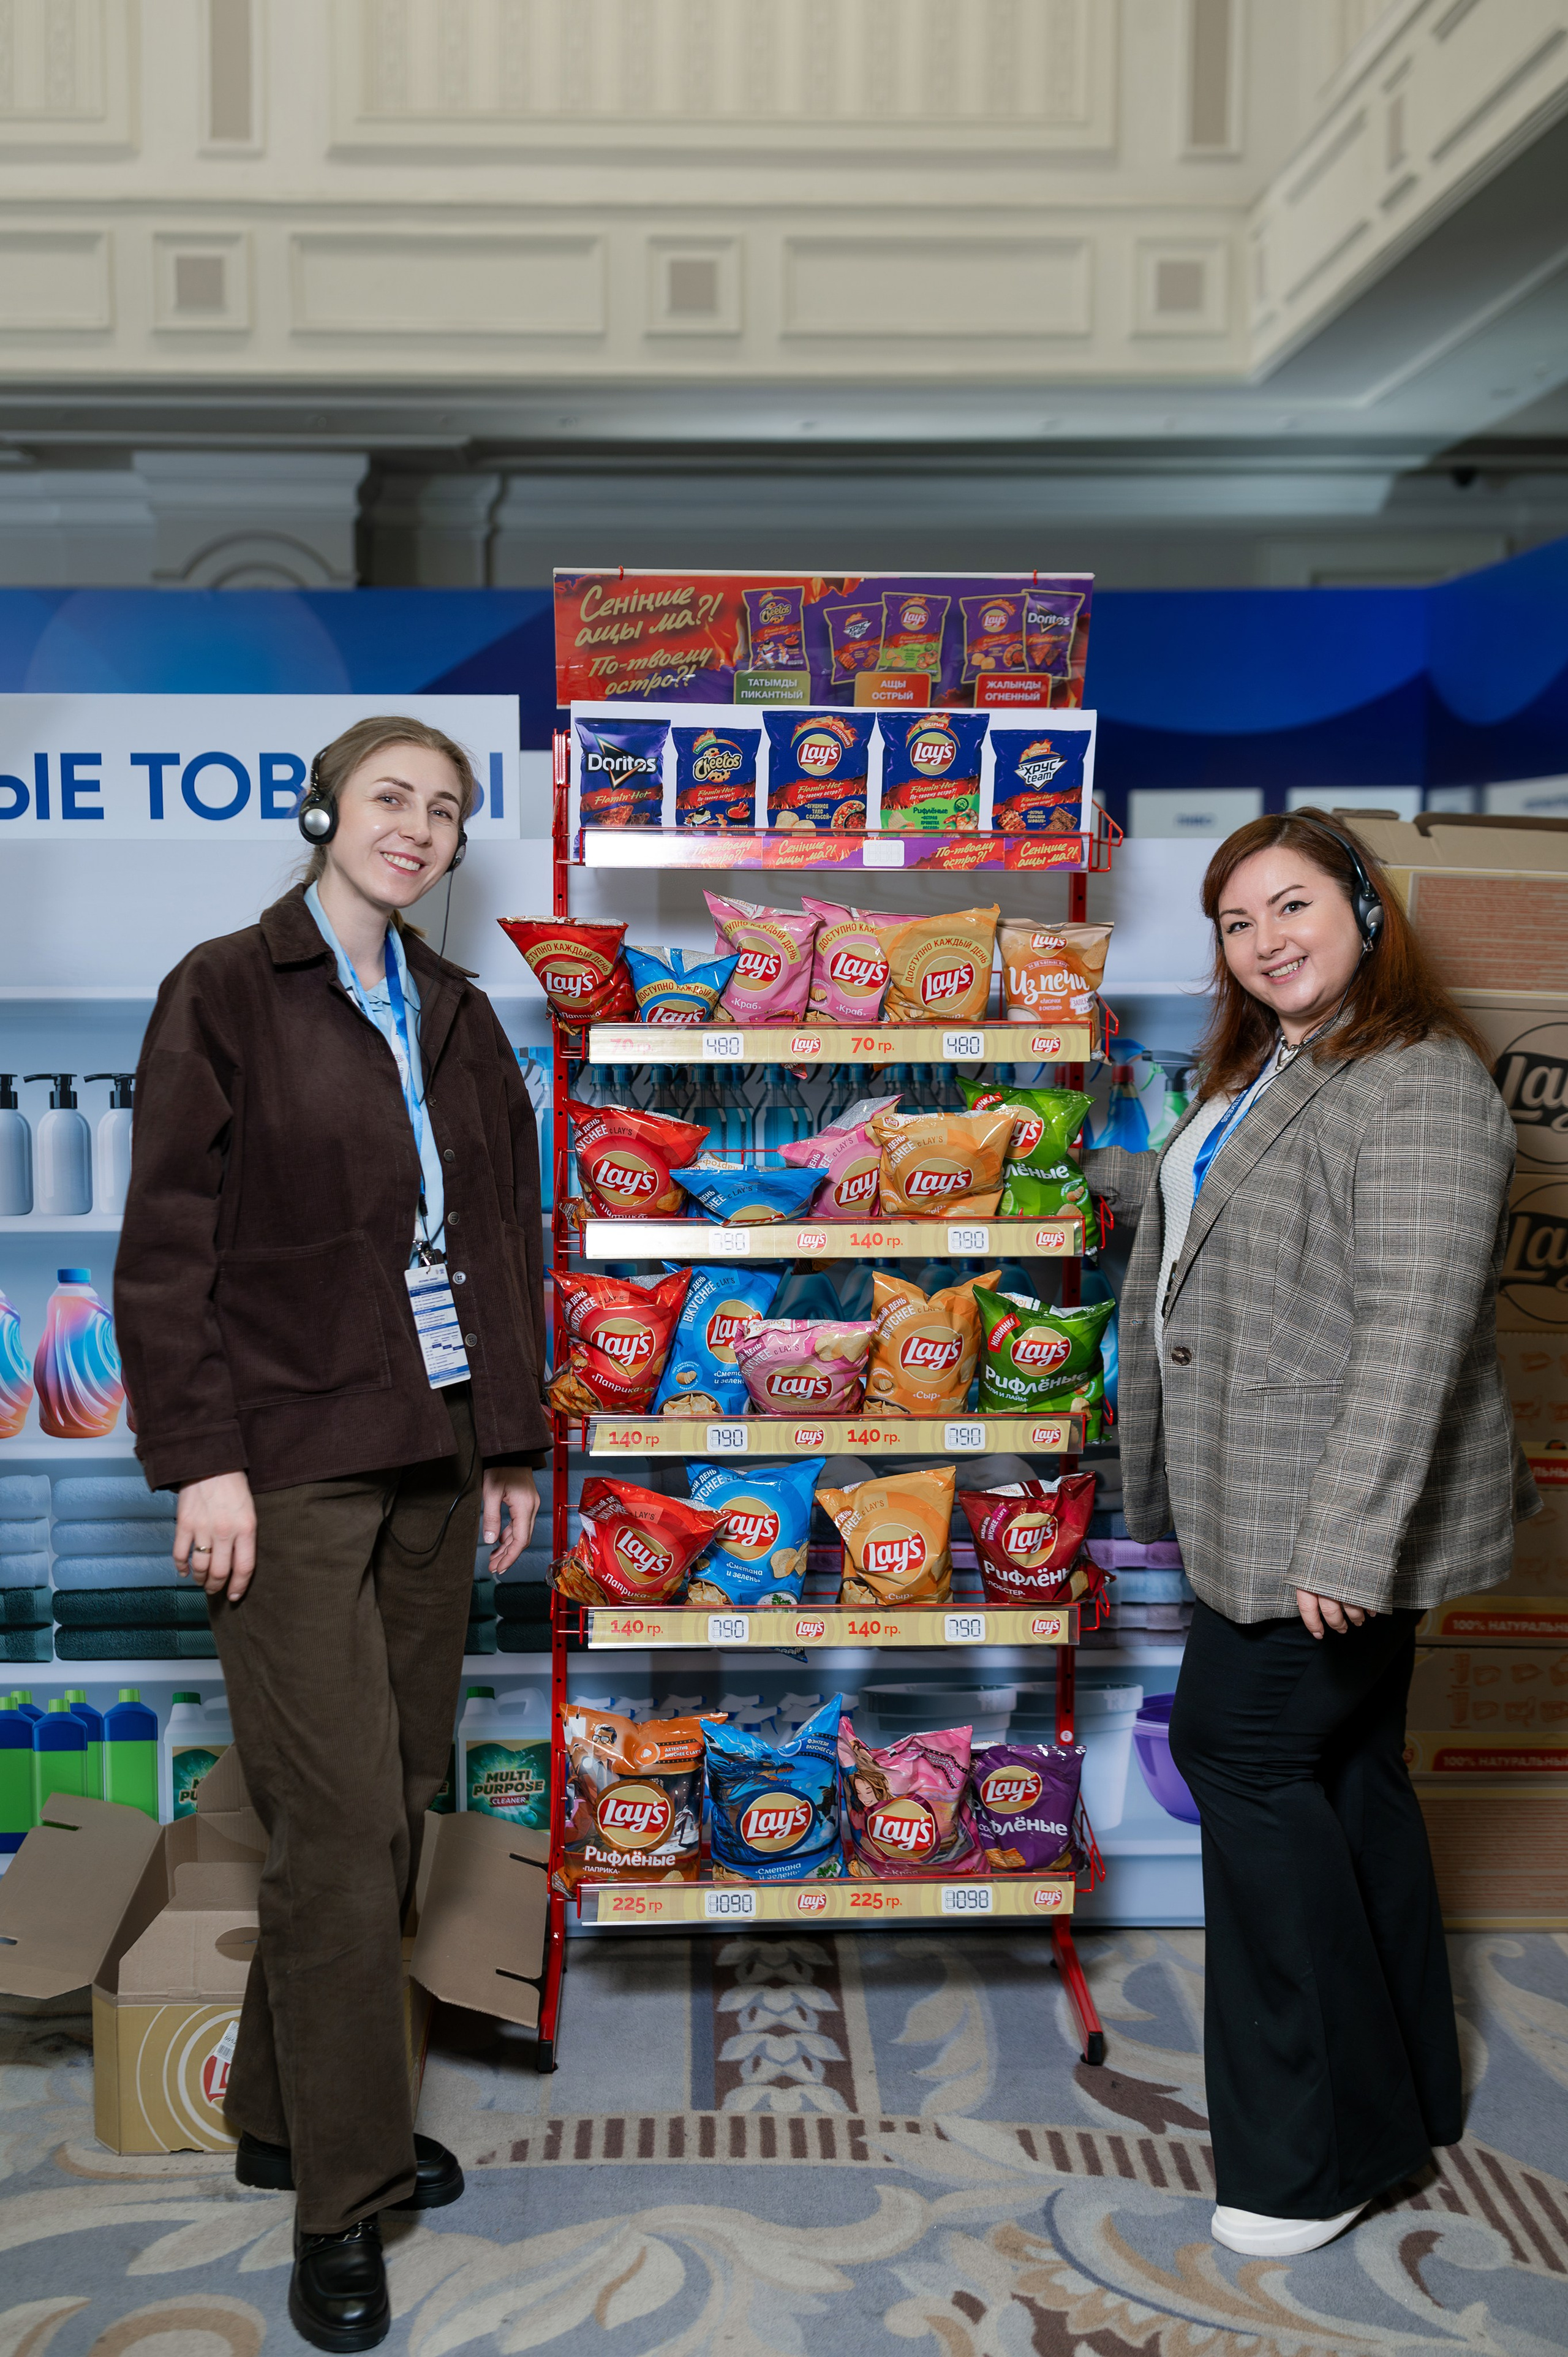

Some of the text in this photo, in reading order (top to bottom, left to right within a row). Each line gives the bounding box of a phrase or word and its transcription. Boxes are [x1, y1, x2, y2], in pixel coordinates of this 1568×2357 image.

[580, 585, 695, 622] Сеніңше
[575, 592, 724, 647] ащы ма?!
[760, 603, 791, 624] Cheetos
[903, 611, 927, 625] Lay's
[984, 615, 1006, 627] Lay's
[1027, 613, 1070, 626] Doritos
[588, 648, 713, 677] По-твоему
[605, 664, 697, 697] остро?!
[748, 679, 797, 687] ТАТЫМДЫ
[880, 680, 907, 689] АЩЫ
[986, 681, 1041, 689] ЖАЛЫНДЫ
[741, 690, 803, 700] ПИКАНТНЫЙ
[872, 690, 914, 700] ОСТРЫЙ
[985, 690, 1040, 700] ОГНЕННЫЙ
[832, 725, 850, 746] ОГНЕННЫЙ
[695, 738, 715, 753] ПИКАНТНЫЙ
[588, 753, 658, 772] Doritos
[801, 744, 839, 766] Lay's
[913, 743, 953, 766] Lay's
[693, 751, 742, 781] Cheetos
[1024, 760, 1057, 776] ХРУС
[1027, 772, 1052, 783] team
[693, 839, 753, 857] По-твоему
[775, 844, 837, 866] ащы ма?!
[778, 839, 826, 855] Сеніңше
[935, 841, 995, 858] По-твоему
[1020, 841, 1068, 858] Сеніңше
[701, 848, 745, 864] остро?!
[943, 850, 987, 867] остро?!
[1017, 846, 1079, 868] ащы ма?!
[819, 923, 857, 950] ДОСТУПНО
[1033, 934, 1066, 950] Lay's
[783, 938, 797, 960] ДЕНЬ
[553, 944, 610, 973] КАЖДЫЙ ДЕНЬ
[905, 938, 988, 983] ДОСТУПНО КАЖДЫЙ ДЕНЬ
[832, 953, 888, 986] Lay's
[546, 971, 594, 998] Lay's
[925, 965, 971, 1001] Lay's
[1009, 966, 1090, 1005] Из печи
[638, 982, 674, 1004] ДОСТУПНО
[731, 997, 761, 1010] «Краб»
[836, 1005, 866, 1016] «Краб»
[610, 1039, 633, 1053] 70
[793, 1037, 820, 1056] Lay's
[851, 1037, 894, 1055] 70 гр.
[948, 1036, 979, 1054] 480
[1033, 1036, 1060, 1054] Lay's
[582, 1119, 600, 1133] ДЕНЬ
[614, 1127, 633, 1136] LAY'S
[835, 1137, 854, 1152] LAY'S
[888, 1135, 907, 1152] ДЕНЬ
[923, 1135, 943, 1146] LAY'S
[595, 1159, 655, 1195] Lay's
[908, 1169, 971, 1197] Lay's
[698, 1190, 715, 1203] ДЕНЬ
[732, 1185, 753, 1197] LAY'S
[799, 1233, 826, 1250] Lay's
[850, 1232, 903, 1249] 140 гр.
[953, 1231, 984, 1249] 790
[1038, 1231, 1066, 1248] Lay's
[693, 1276, 706, 1292] ДЕНЬ
[570, 1290, 587, 1306] ДЕНЬ
[683, 1277, 736, 1323] ВКУСНЕЕ LAY'S
[888, 1297, 907, 1312] ДЕНЬ
[571, 1296, 598, 1332] ВКУСНЕЕ
[881, 1304, 916, 1340] ВКУСНЕЕ
[990, 1317, 1016, 1347] НОВИНКА
[597, 1331, 651, 1367] Lay's
[743, 1343, 762, 1357] ДЕНЬ
[903, 1337, 962, 1370] Lay's
[1015, 1340, 1068, 1366] Lay's
[592, 1374, 643, 1393] «Паприка»
[771, 1375, 828, 1399] Lay's
[986, 1364, 1088, 1395] Рифлёные
[913, 1391, 941, 1401] «Сыр»
[609, 1431, 642, 1447] 140
[712, 1428, 743, 1444] 790
[796, 1429, 823, 1445] Lay's
[848, 1429, 900, 1445] 140 гр.
[949, 1427, 981, 1443] 790
[1033, 1428, 1061, 1443] Lay's
[699, 1469, 717, 1483] ДЕНЬ
[865, 1500, 884, 1513] LAY'S
[635, 1511, 655, 1520] LAY'S
[1008, 1521, 1058, 1554] Lay's
[617, 1529, 670, 1573] Lay's
[869, 1535, 921, 1574] Lay's
[726, 1561, 763, 1577] «Сметана
[732, 1571, 761, 1583] зелень»
[601, 1573, 651, 1599] «Паприка»
[611, 1620, 663, 1636] 140 гр.
[713, 1619, 744, 1635] 790
[797, 1620, 823, 1636] Lay's
[848, 1621, 900, 1637] 140 гр.
[949, 1619, 981, 1634] 790
[1033, 1619, 1060, 1635] Lay's
[486, 1769, 531, 1783] MULTI
[473, 1780, 544, 1796] PURPOSE
[986, 1777, 1038, 1803] Lay's
[492, 1796, 527, 1805] CLEANER
[603, 1800, 666, 1833] Lay's
[747, 1806, 807, 1839] Lay's
[873, 1815, 933, 1851] Lay's
[584, 1845, 676, 1867] Рифлёные
[613, 1897, 646, 1913] 225
[799, 1894, 826, 1910] Lay's
[850, 1893, 902, 1909] 225 гр.
[1035, 1889, 1063, 1905] Lay's
